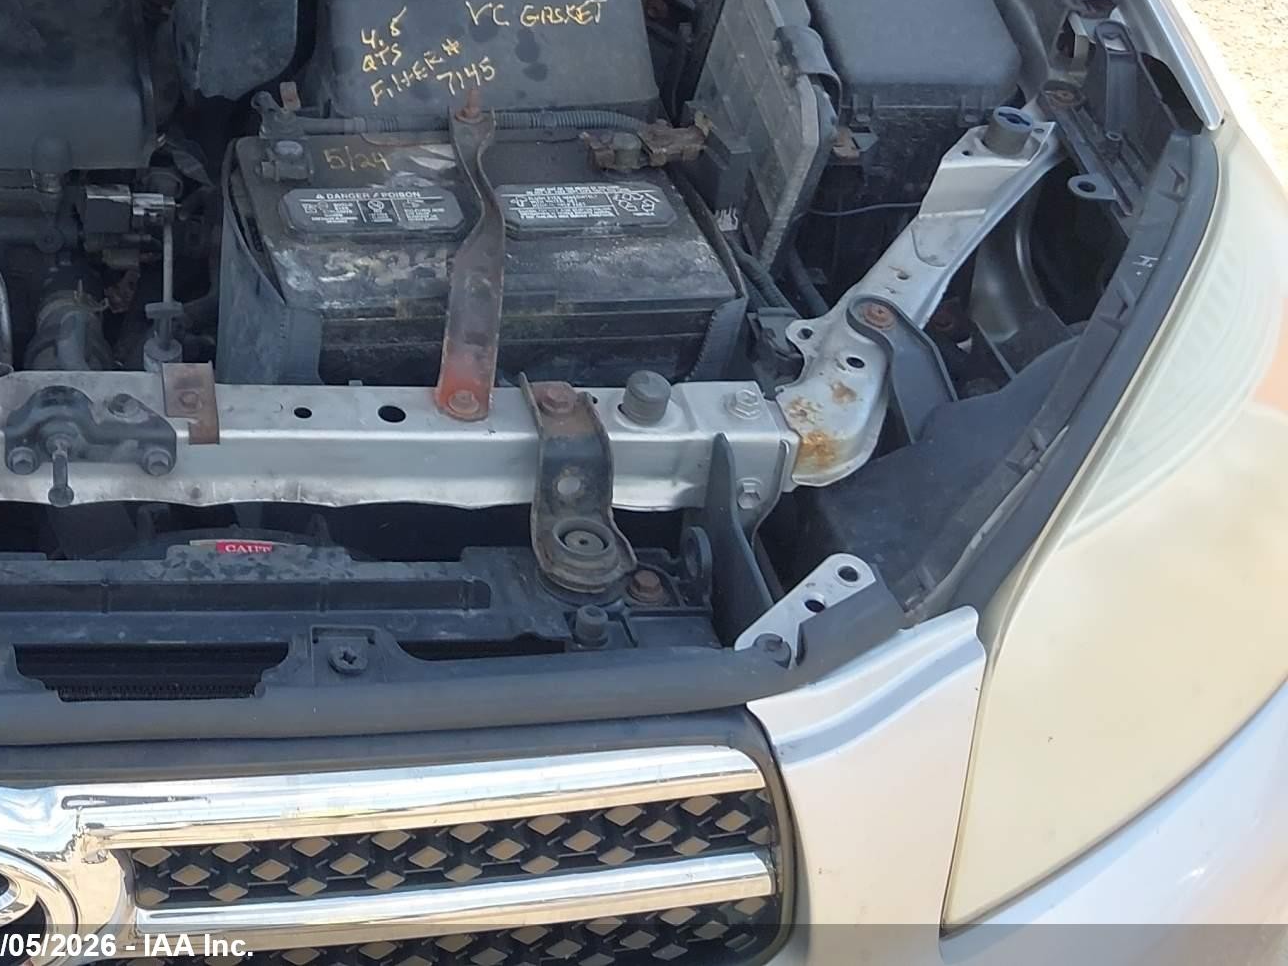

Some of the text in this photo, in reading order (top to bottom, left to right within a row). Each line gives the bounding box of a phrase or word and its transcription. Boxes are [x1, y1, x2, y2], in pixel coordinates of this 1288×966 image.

[465, 0, 510, 27] VC
[362, 42, 402, 72] QTS
[435, 56, 496, 96] 7145
[323, 145, 392, 172] 5/24
[326, 191, 370, 200] DANGER
